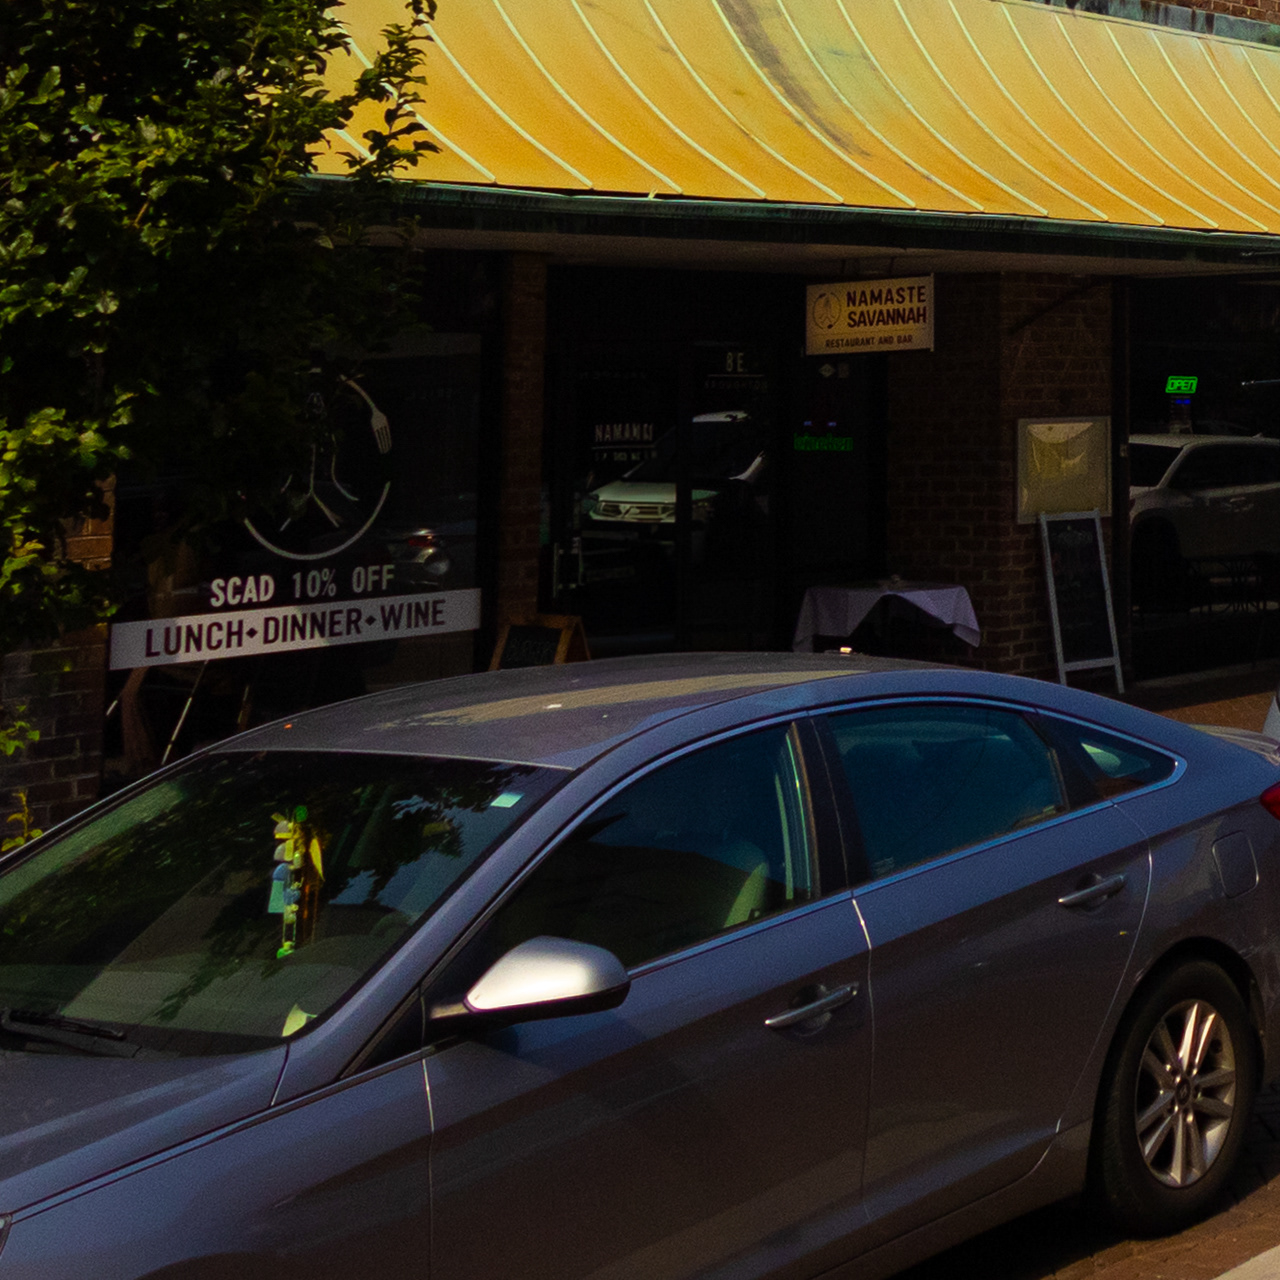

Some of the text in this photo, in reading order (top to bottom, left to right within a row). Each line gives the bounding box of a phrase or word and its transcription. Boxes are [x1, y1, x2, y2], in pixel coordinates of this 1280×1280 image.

[846, 285, 926, 307] NAMASTE
[847, 306, 927, 328] SAVANNAH
[825, 334, 913, 348] RESTAURANT AND BAR
[209, 564, 397, 608] SCAD 10% OFF
[145, 599, 447, 658] LUNCH DINNER WINE
